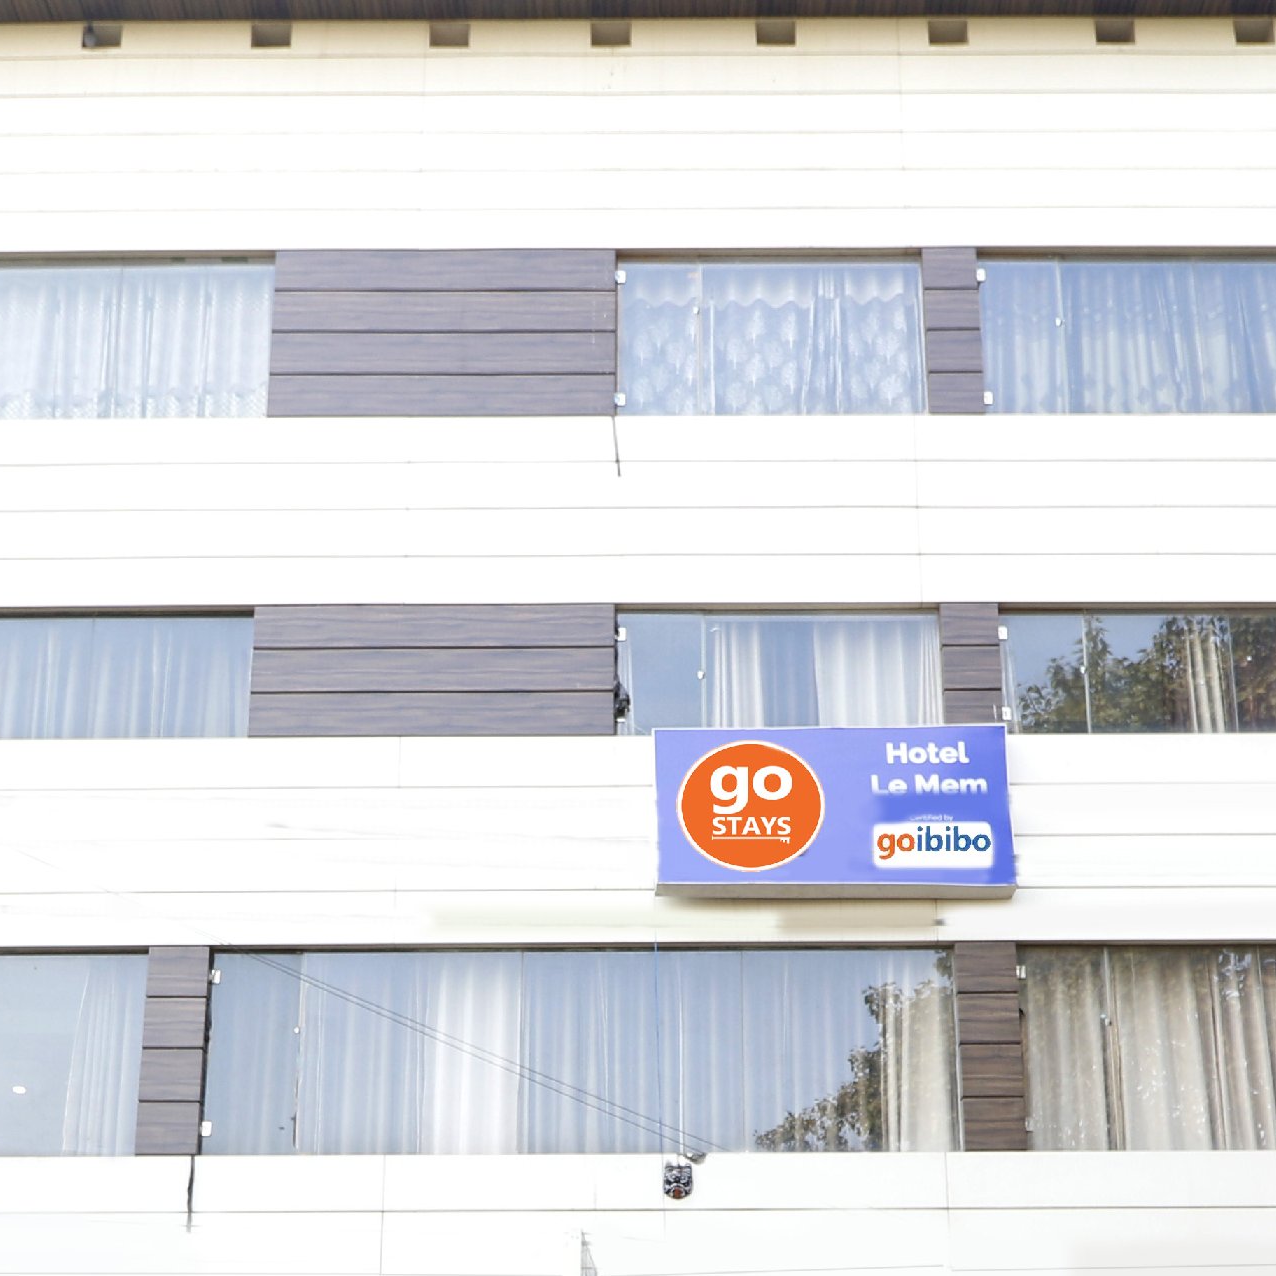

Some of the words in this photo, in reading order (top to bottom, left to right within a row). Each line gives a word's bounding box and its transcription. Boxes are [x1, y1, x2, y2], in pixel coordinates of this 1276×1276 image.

[885, 741, 970, 764] Hotel
[709, 764, 793, 815] go
[870, 774, 908, 795] Le
[915, 774, 988, 795] Mem
[711, 816, 792, 836] STAYS
[876, 825, 991, 860] goibibo
